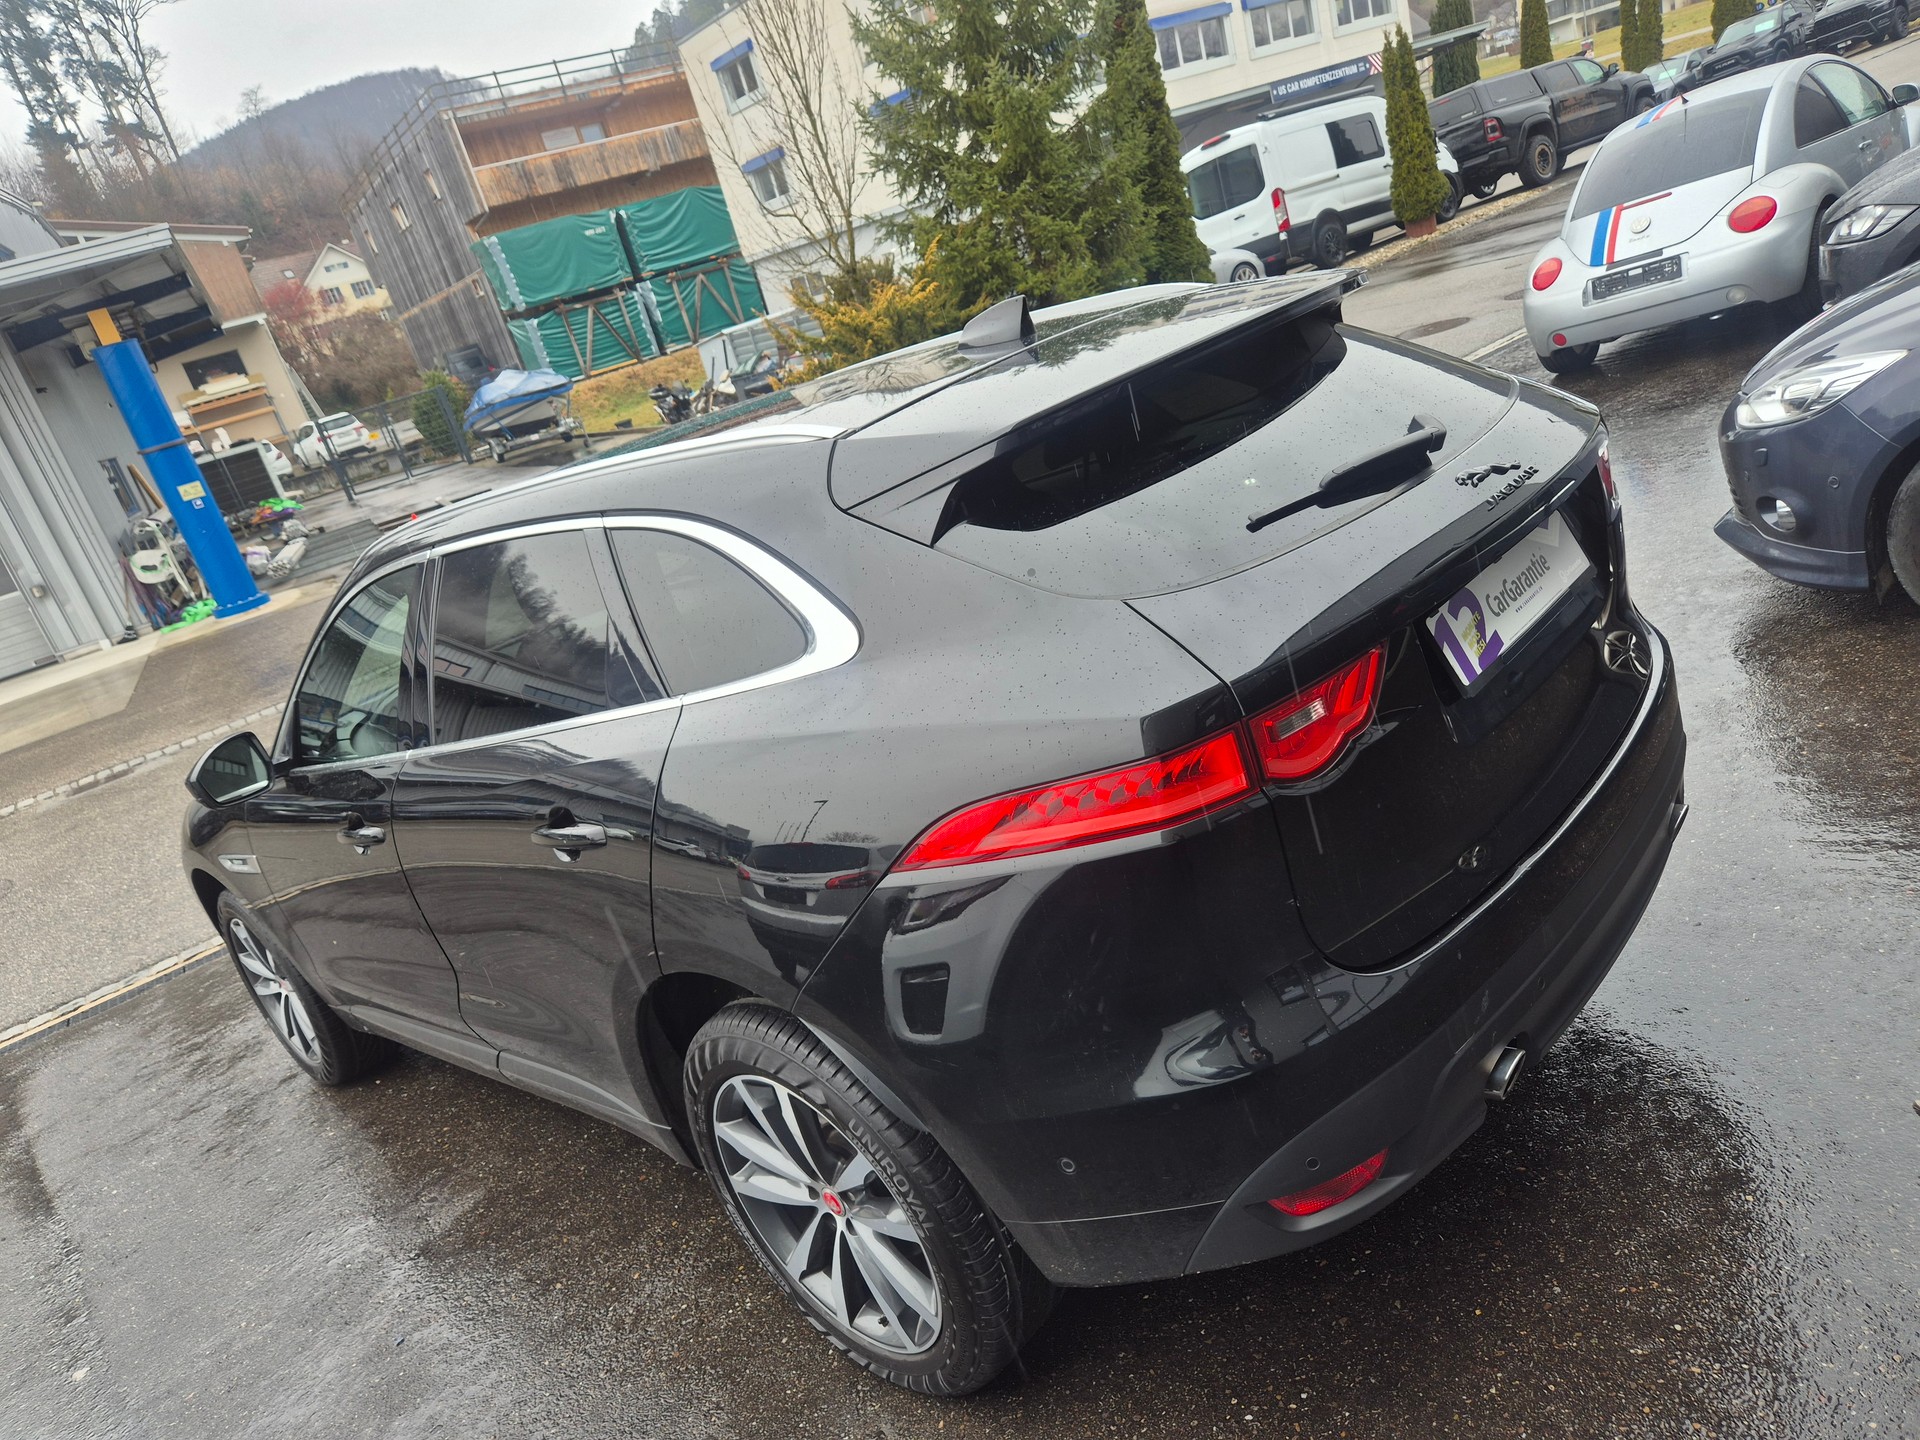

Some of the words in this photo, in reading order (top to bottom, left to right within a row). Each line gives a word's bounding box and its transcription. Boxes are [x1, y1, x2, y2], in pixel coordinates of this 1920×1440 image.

[1278, 85, 1287, 95] US
[1287, 81, 1300, 93] CAR
[1300, 64, 1358, 89] KOMPETENZZENTRUM
[1486, 465, 1540, 512] JAGUAR
[1485, 552, 1551, 617] CarGarantie
[1434, 586, 1505, 684] 12
[848, 1118, 935, 1237] UNIROYAL
